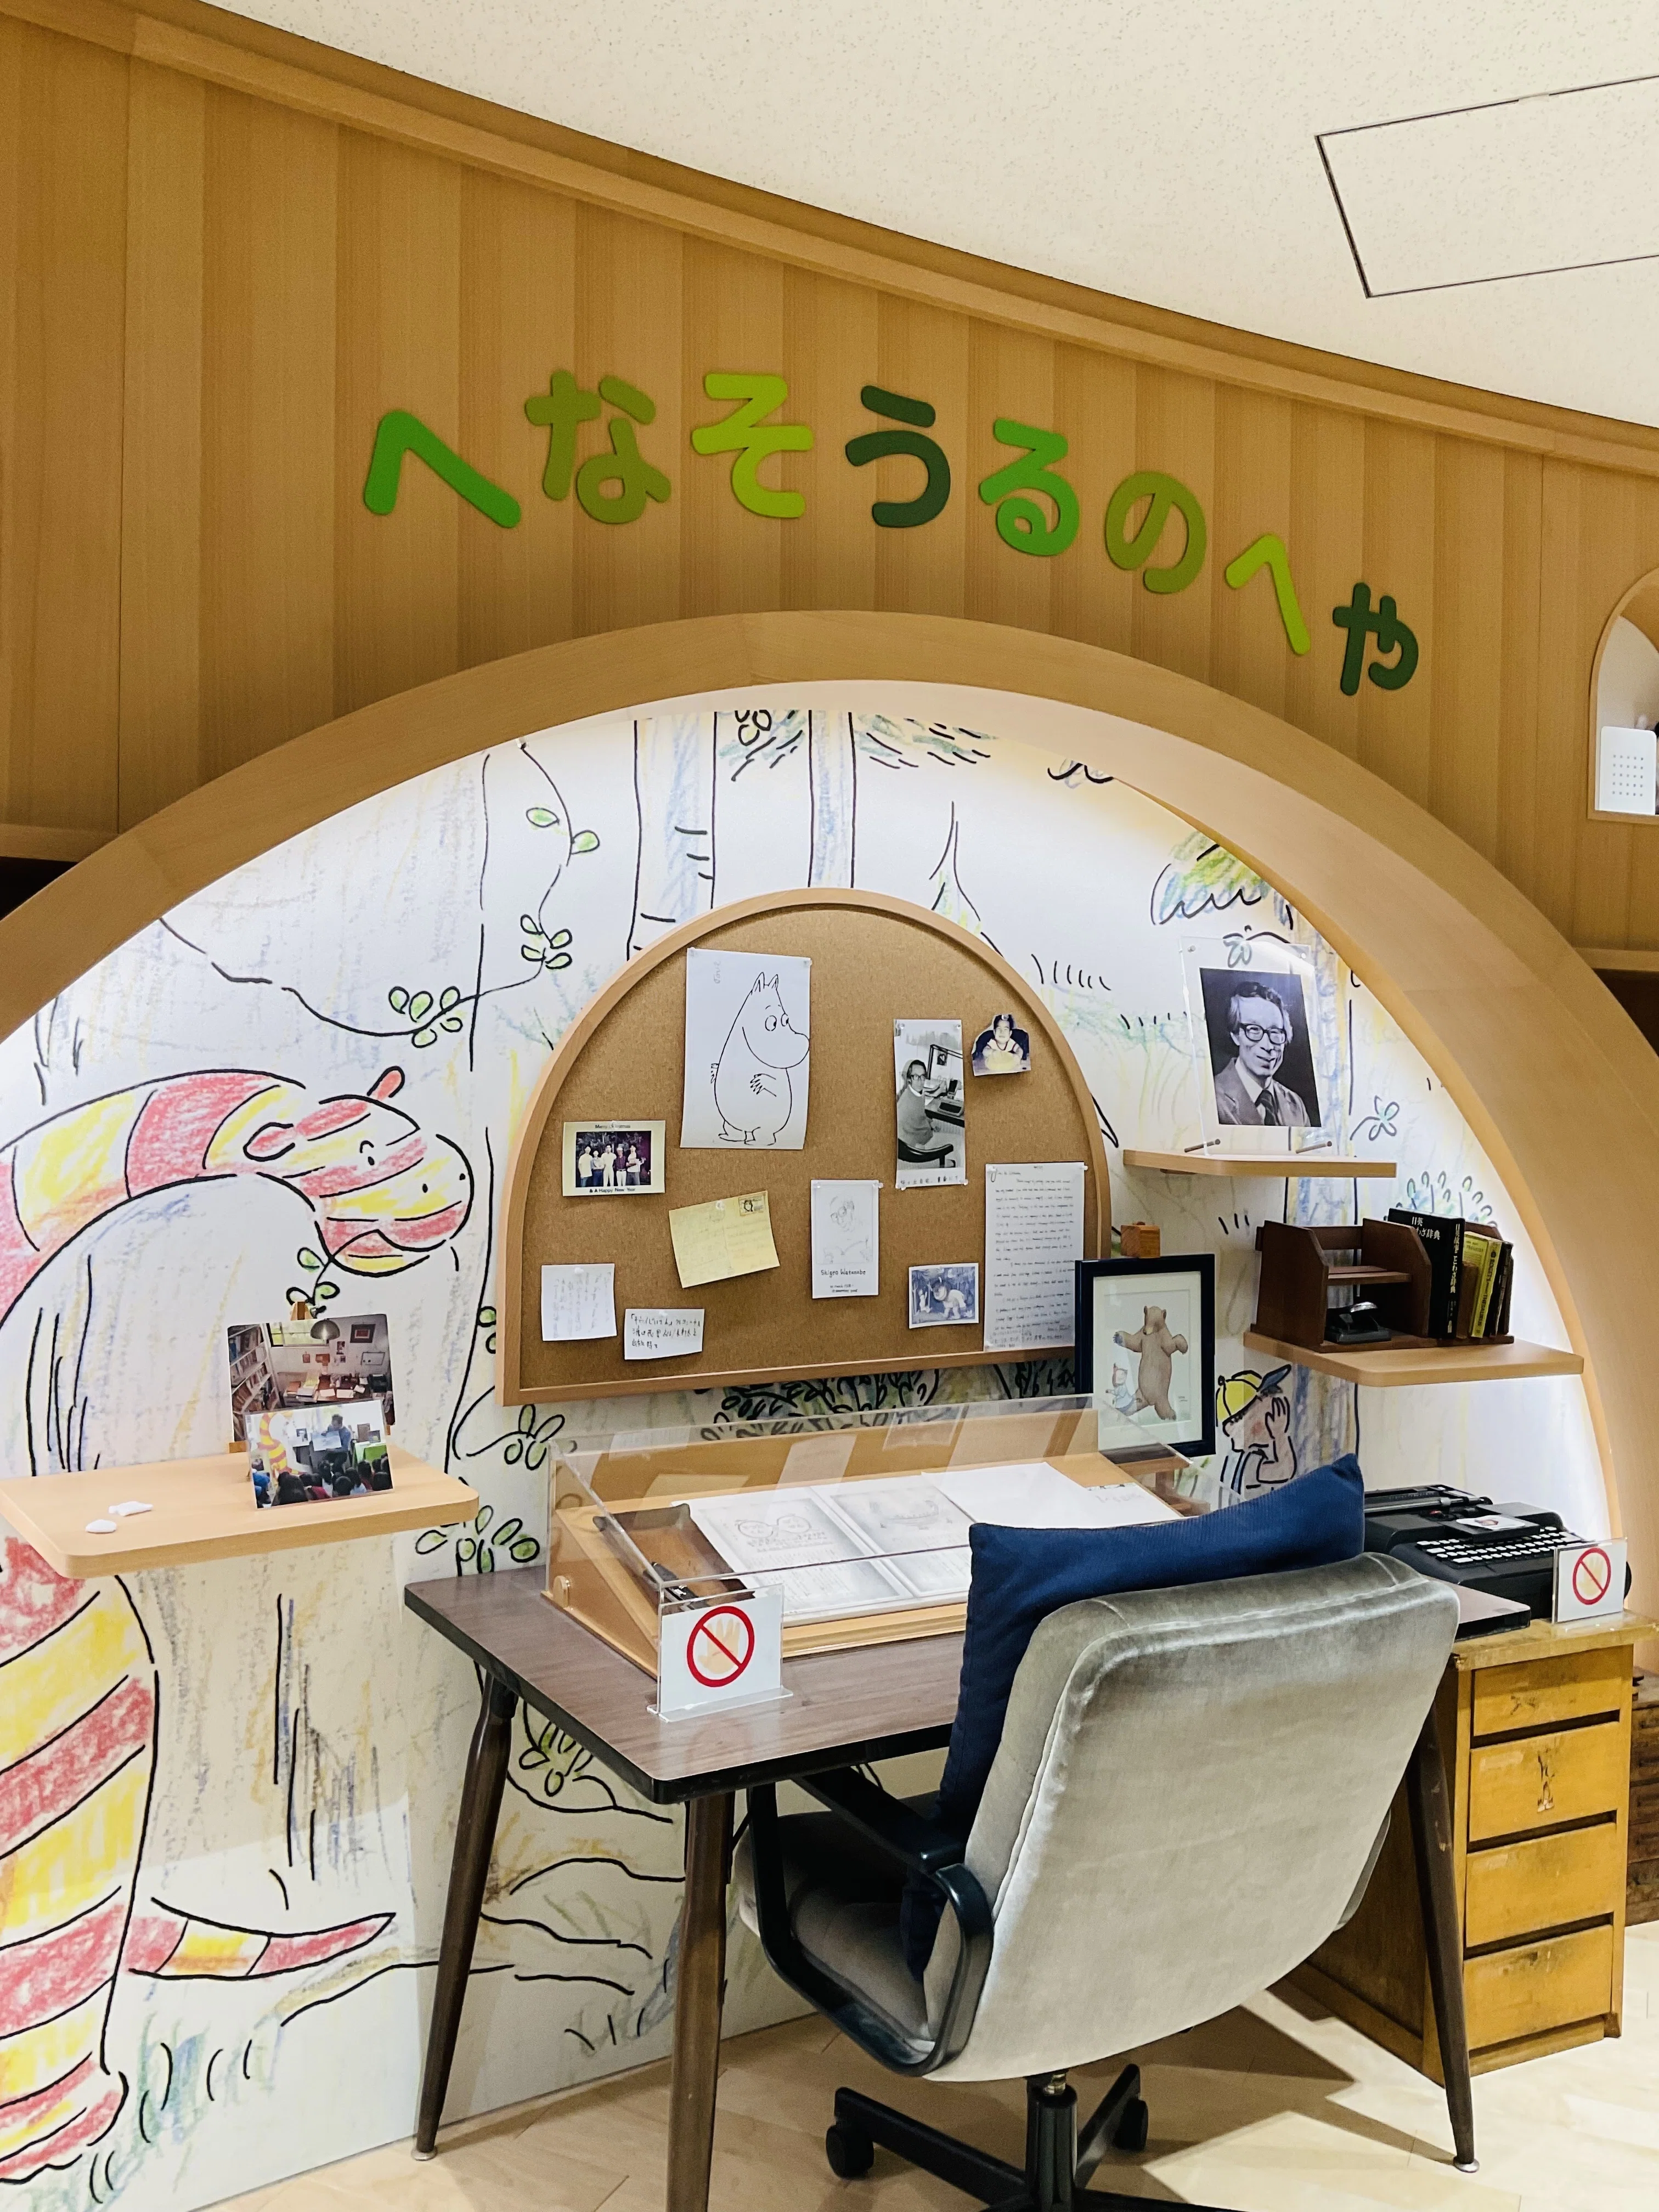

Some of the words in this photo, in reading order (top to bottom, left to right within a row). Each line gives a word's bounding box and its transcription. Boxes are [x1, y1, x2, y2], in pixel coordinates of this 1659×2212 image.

[363, 370, 1419, 697] へなそうるのへや
